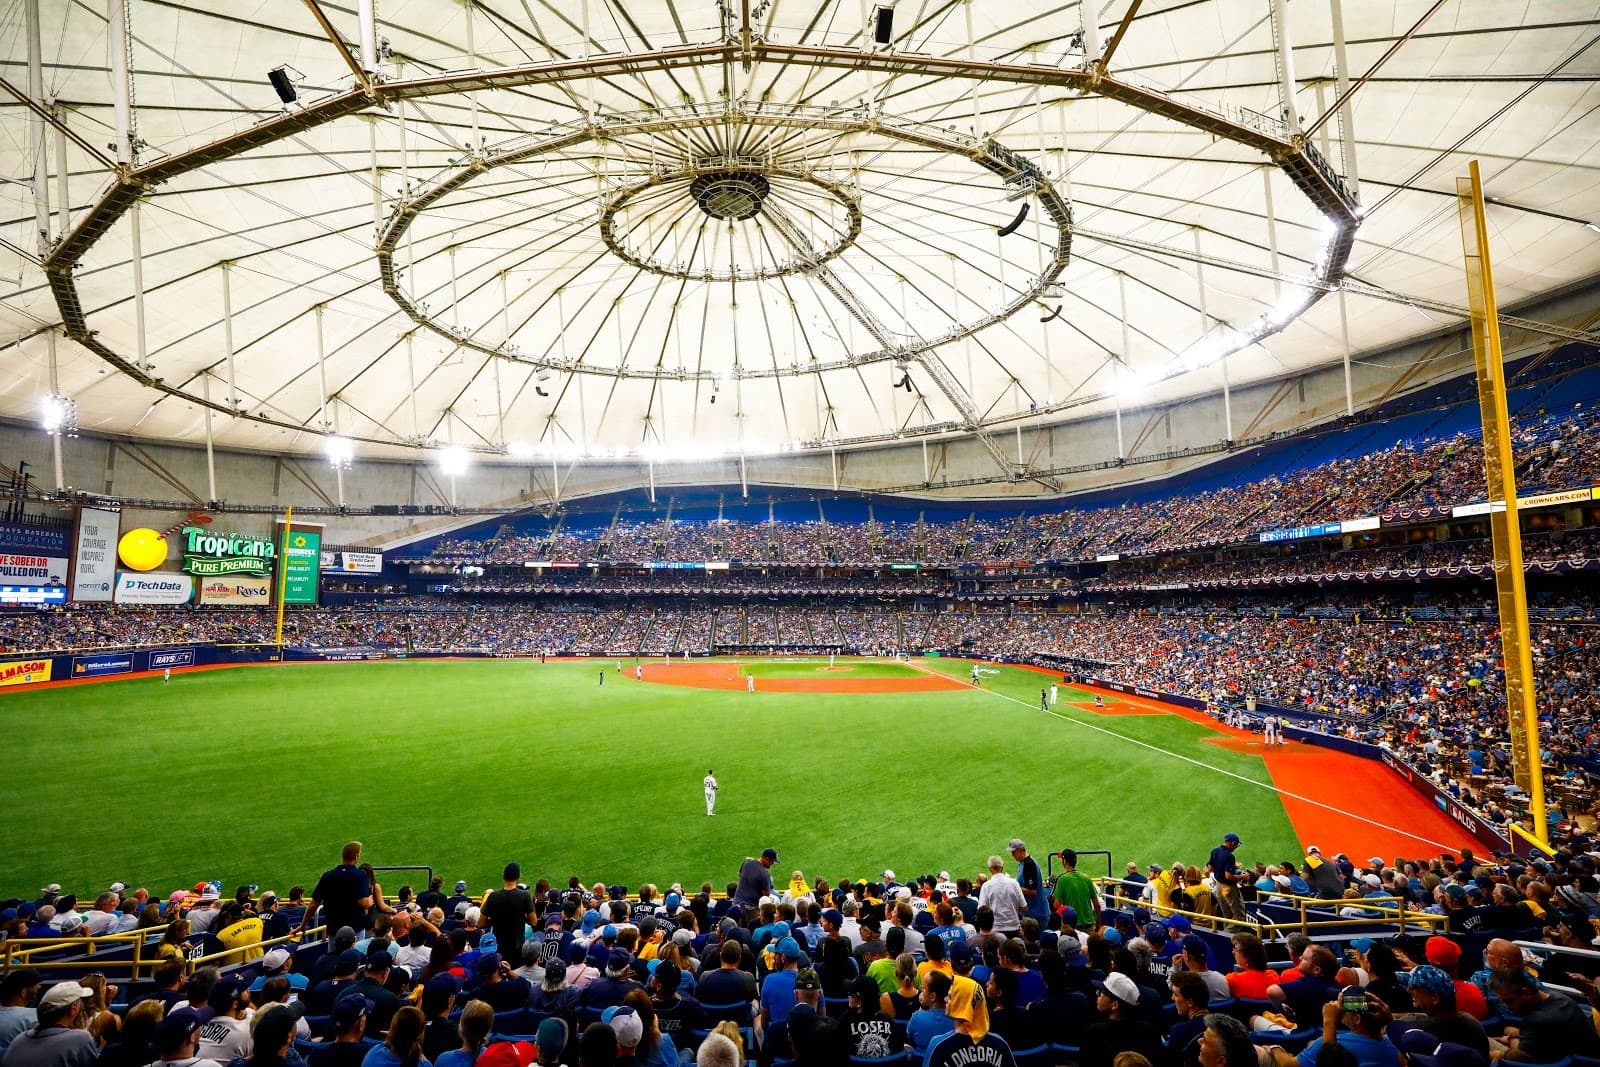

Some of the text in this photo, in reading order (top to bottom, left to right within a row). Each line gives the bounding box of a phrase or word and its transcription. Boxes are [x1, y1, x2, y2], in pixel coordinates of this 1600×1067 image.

[1524, 492, 1590, 506] CROWNCARS.COM
[25, 529, 64, 539] BASEBALL
[84, 525, 98, 536] YOUR
[82, 538, 107, 550] COURAGE
[182, 527, 275, 557] Tropicana
[9, 555, 36, 567] SOBER
[37, 557, 48, 567] OR
[81, 550, 105, 562] INSPIRES
[28, 567, 49, 578] OVER
[191, 560, 264, 573] PURE PREMIUM
[259, 586, 267, 595] 6
[1457, 810, 1477, 834] ALDS
[938, 931, 950, 940] THE
[850, 1020, 891, 1035] LOSER
